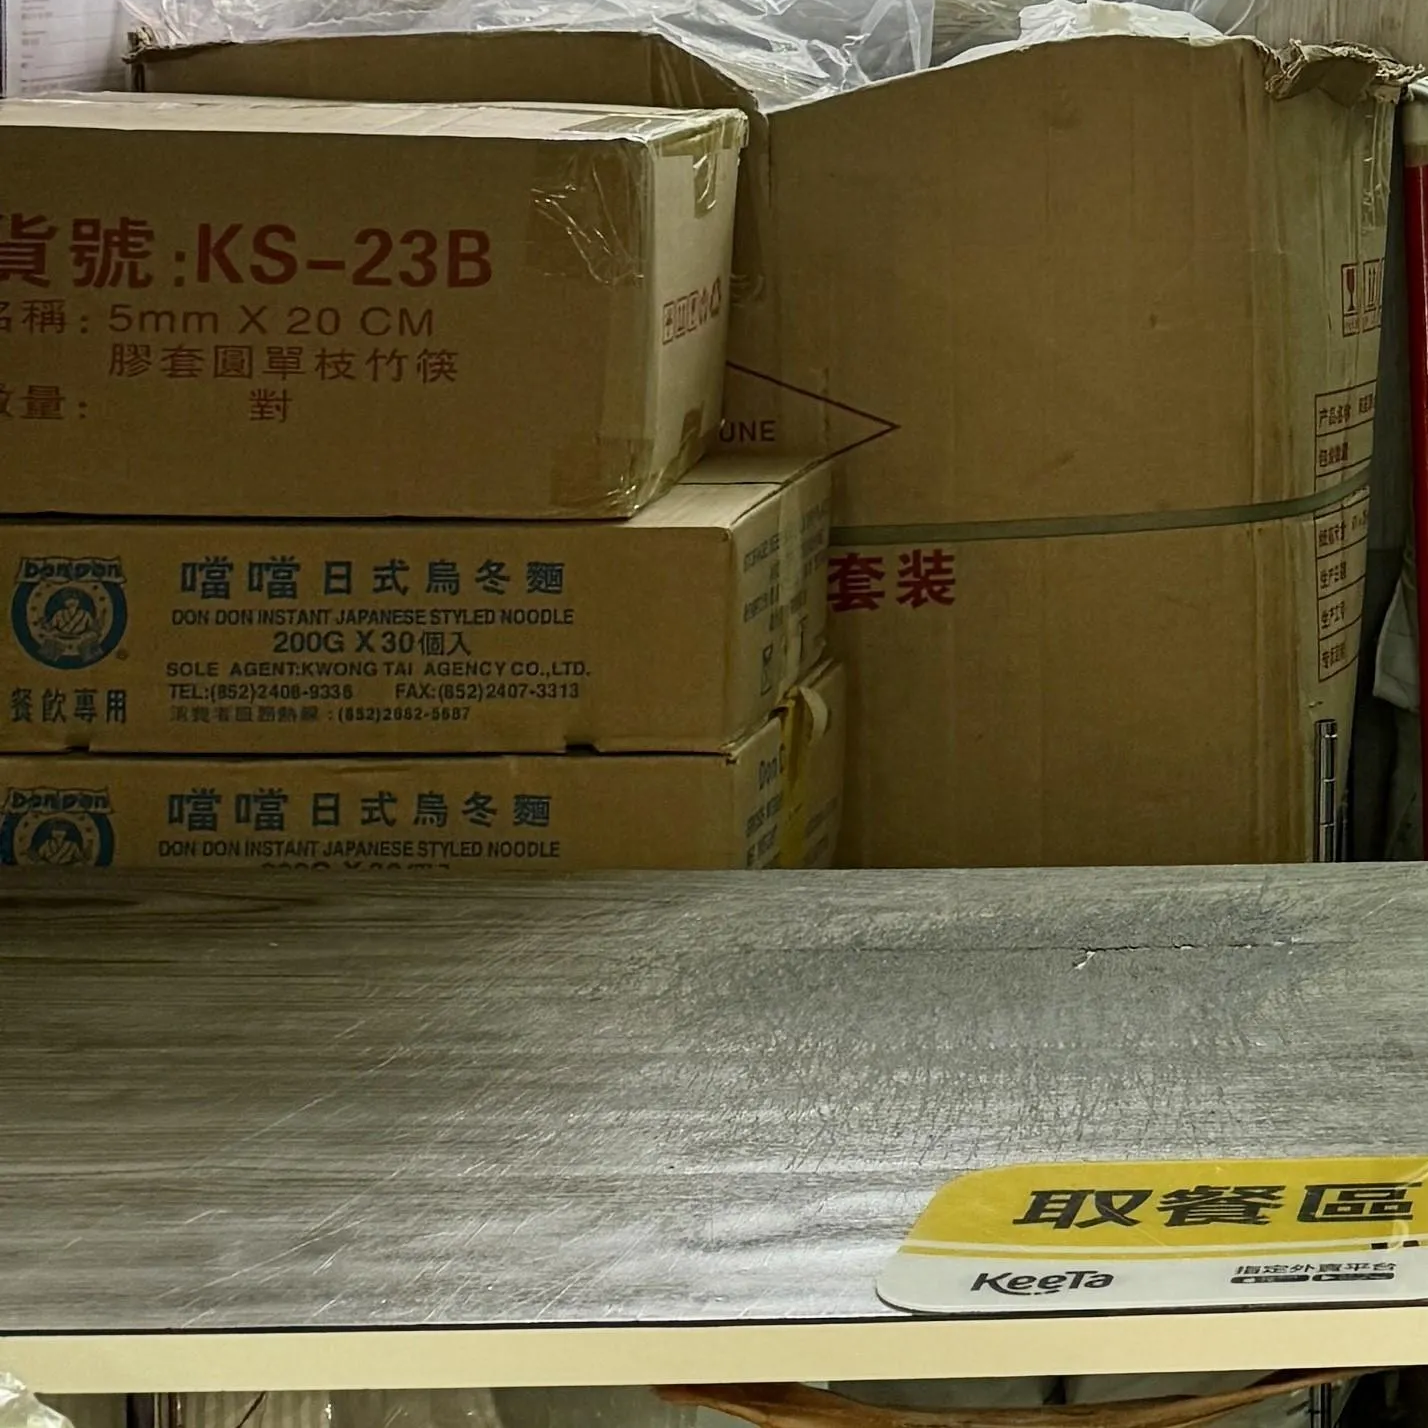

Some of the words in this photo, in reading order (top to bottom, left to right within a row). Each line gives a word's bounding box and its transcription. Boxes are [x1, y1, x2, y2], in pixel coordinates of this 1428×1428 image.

[109, 305, 220, 335] 5mm
[238, 306, 276, 335] X
[290, 306, 345, 338] 20
[360, 305, 434, 338] CM
[108, 345, 459, 381] 膠套圓單枝竹筷
[172, 609, 210, 625] DON
[215, 609, 253, 625] DON
[258, 609, 331, 626] INSTANT
[335, 609, 426, 626] JAPANESE
[430, 609, 496, 626] STYLED
[500, 609, 574, 626] NOODLE
[273, 631, 344, 655] 200G
[167, 662, 220, 677] SOLE
[384, 661, 413, 677] TAI
[424, 661, 506, 678] AGENCY
[1012, 1182, 1423, 1229] 取餐區
